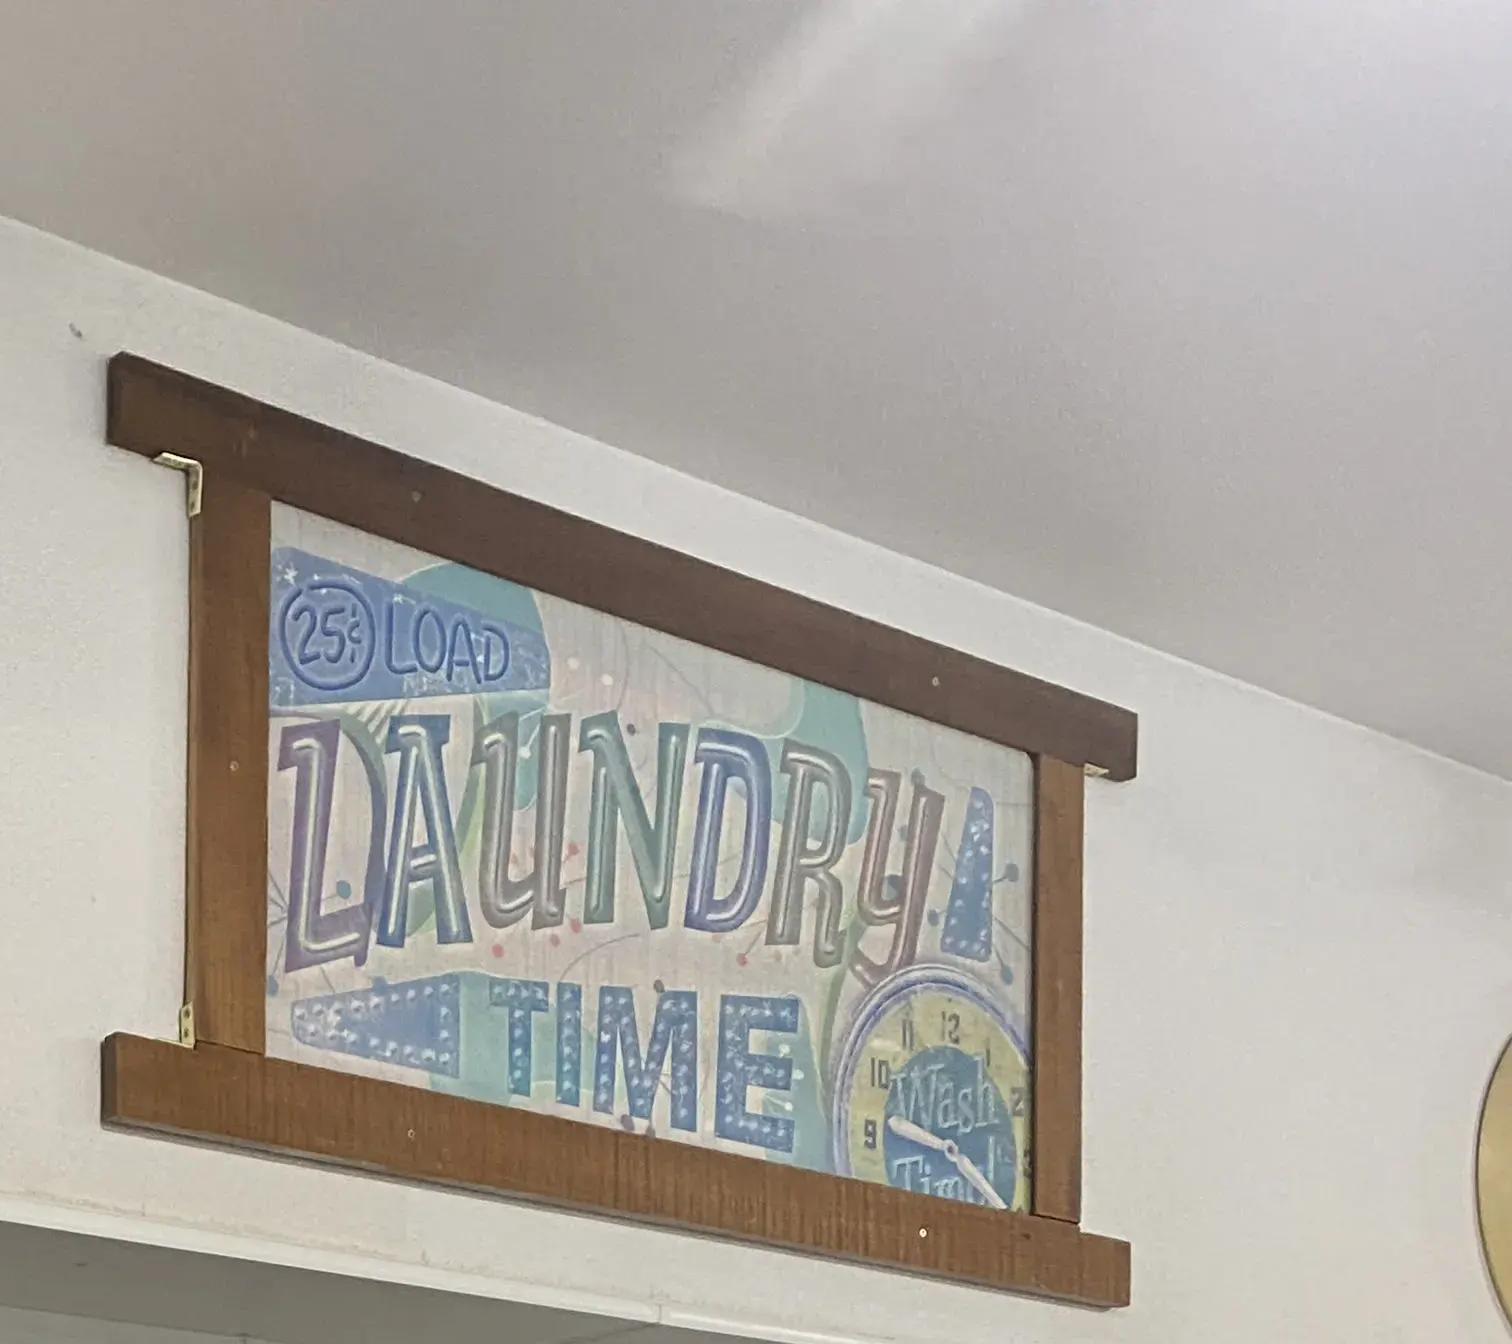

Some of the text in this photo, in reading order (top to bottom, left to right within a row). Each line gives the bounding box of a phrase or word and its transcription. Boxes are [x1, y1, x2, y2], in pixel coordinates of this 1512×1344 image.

[384, 600, 510, 685] LOAD
[277, 710, 945, 988] LAUNDRY
[901, 1018, 914, 1050] 11
[940, 1010, 961, 1045] 12
[487, 980, 801, 1153] TIME
[869, 1056, 889, 1090] 10
[888, 1055, 1001, 1136] Wash
[862, 1118, 877, 1150] 9
